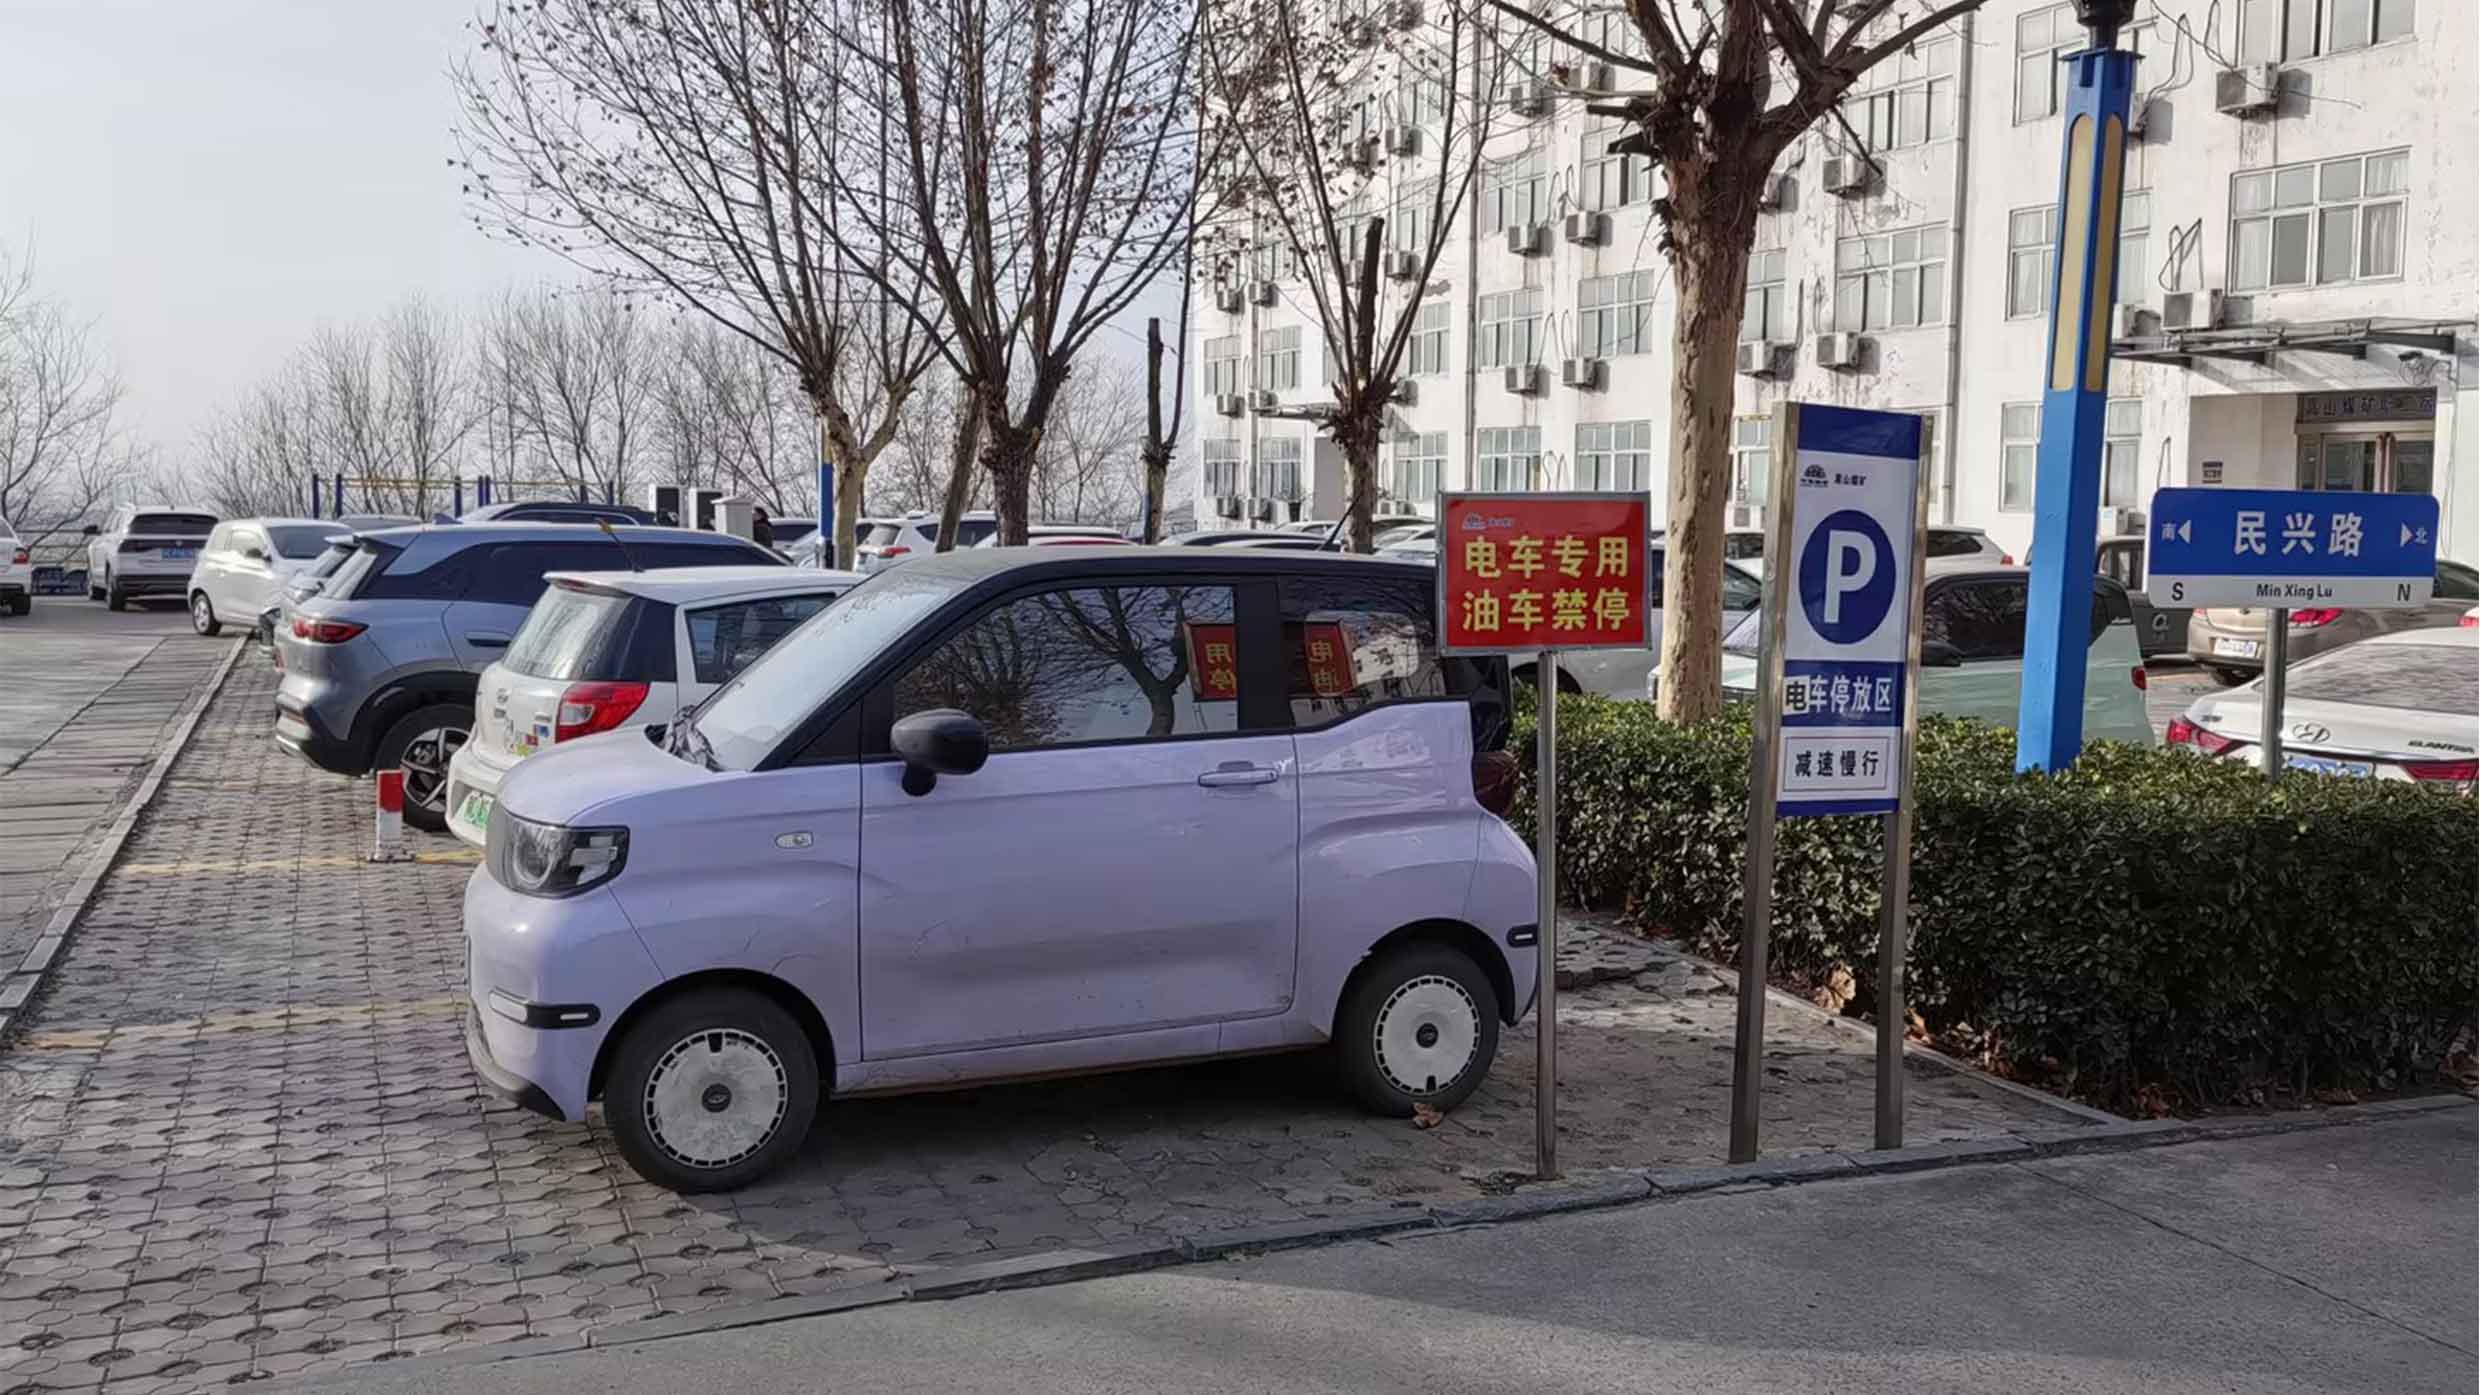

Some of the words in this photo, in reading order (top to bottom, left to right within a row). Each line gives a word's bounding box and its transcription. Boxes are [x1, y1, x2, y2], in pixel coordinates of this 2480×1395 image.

[2161, 523, 2177, 542] 南
[2233, 510, 2364, 557] 民兴路
[2415, 527, 2429, 545] 北
[1464, 535, 1629, 579] 电车专用
[1824, 529, 1877, 623] P
[2171, 582, 2184, 601] S
[2256, 583, 2281, 598] Min
[2284, 584, 2314, 600] Xing
[2317, 585, 2332, 599] Lu
[2397, 584, 2411, 601] N
[1462, 587, 1630, 632] 油车禁停
[1785, 674, 1893, 713] 电车停放区
[1795, 750, 1879, 777] 减速慢行
